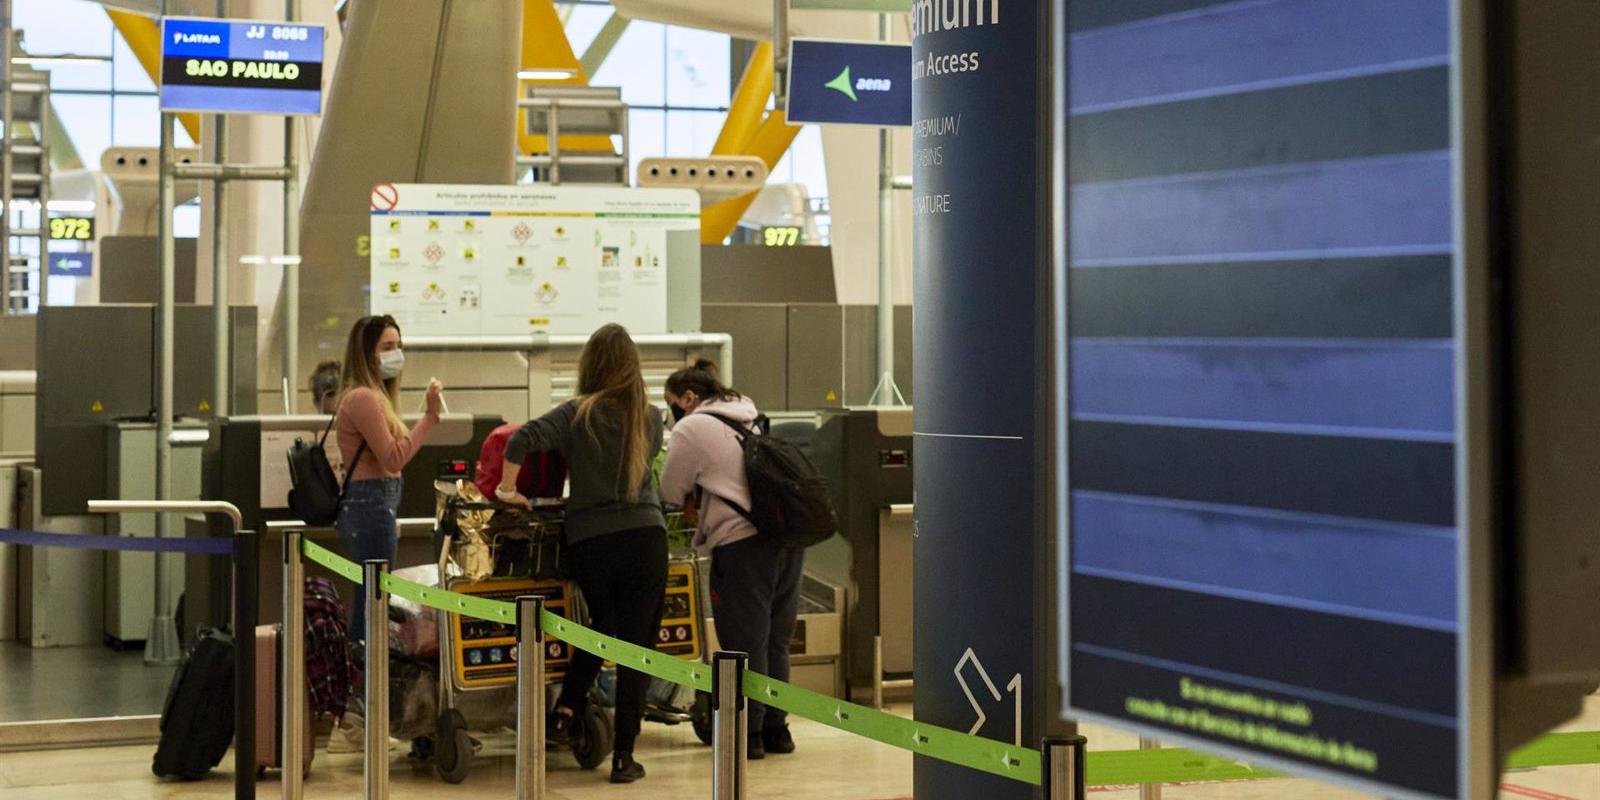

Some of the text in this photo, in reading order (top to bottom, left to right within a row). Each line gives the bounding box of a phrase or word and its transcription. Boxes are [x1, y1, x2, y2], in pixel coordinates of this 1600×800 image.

[183, 34, 220, 45] LATAM
[246, 26, 265, 39] JJ
[186, 59, 300, 80] SAO PAULO
[927, 52, 979, 76] Access
[855, 78, 892, 91] aena
[50, 218, 91, 239] 972
[764, 227, 799, 247] 977
